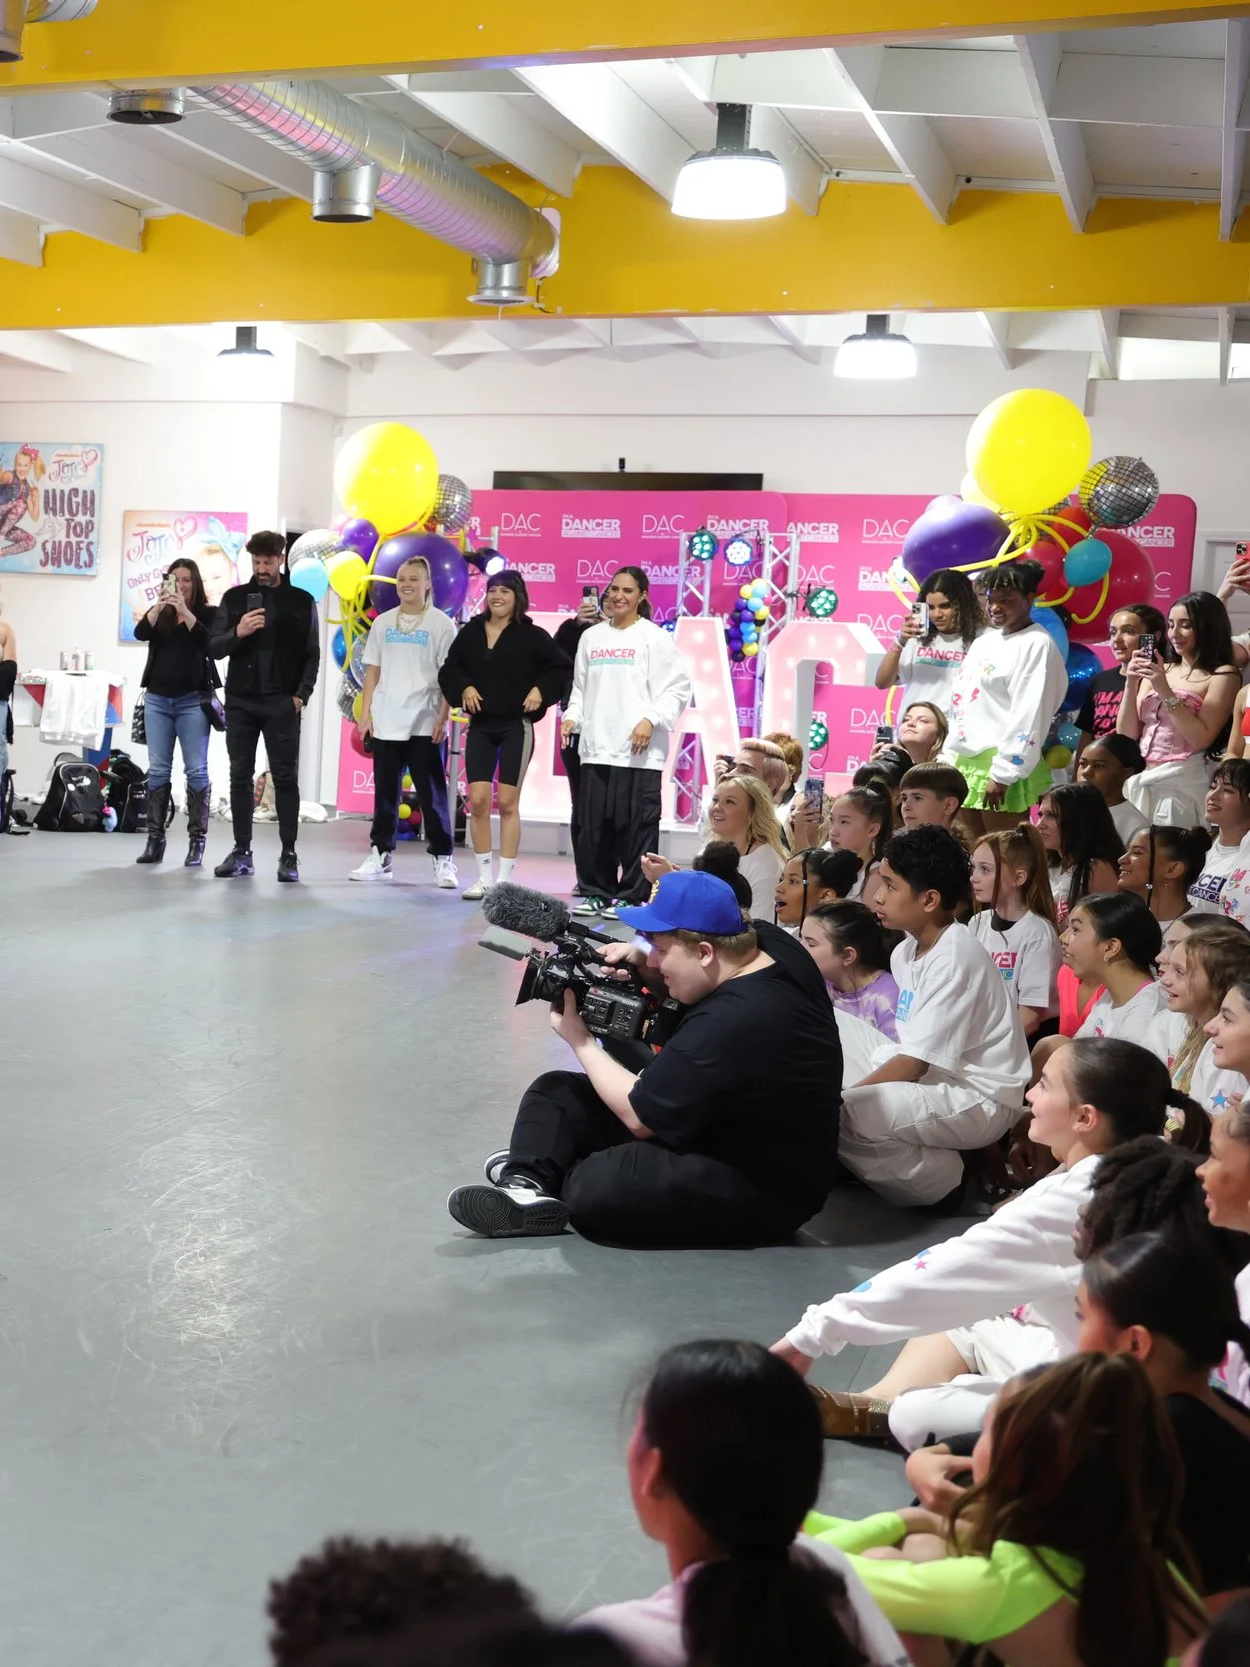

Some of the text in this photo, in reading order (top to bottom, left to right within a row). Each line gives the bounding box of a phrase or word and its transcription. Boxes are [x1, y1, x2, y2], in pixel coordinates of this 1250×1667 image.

[44, 488, 95, 518] HIGH
[65, 518, 94, 539] TOP
[501, 512, 541, 531] DAC
[561, 518, 620, 530] DANCER
[642, 514, 684, 533] DAC
[707, 519, 769, 530] DANCER
[787, 522, 839, 534] ANCER
[863, 519, 909, 538] DAC
[1114, 526, 1175, 538] NCER
[39, 540, 94, 569] SHOES
[577, 560, 618, 577] DAC
[654, 607, 678, 622] AC
[590, 648, 635, 659] DANCER
[1190, 888, 1219, 902] CANCE
